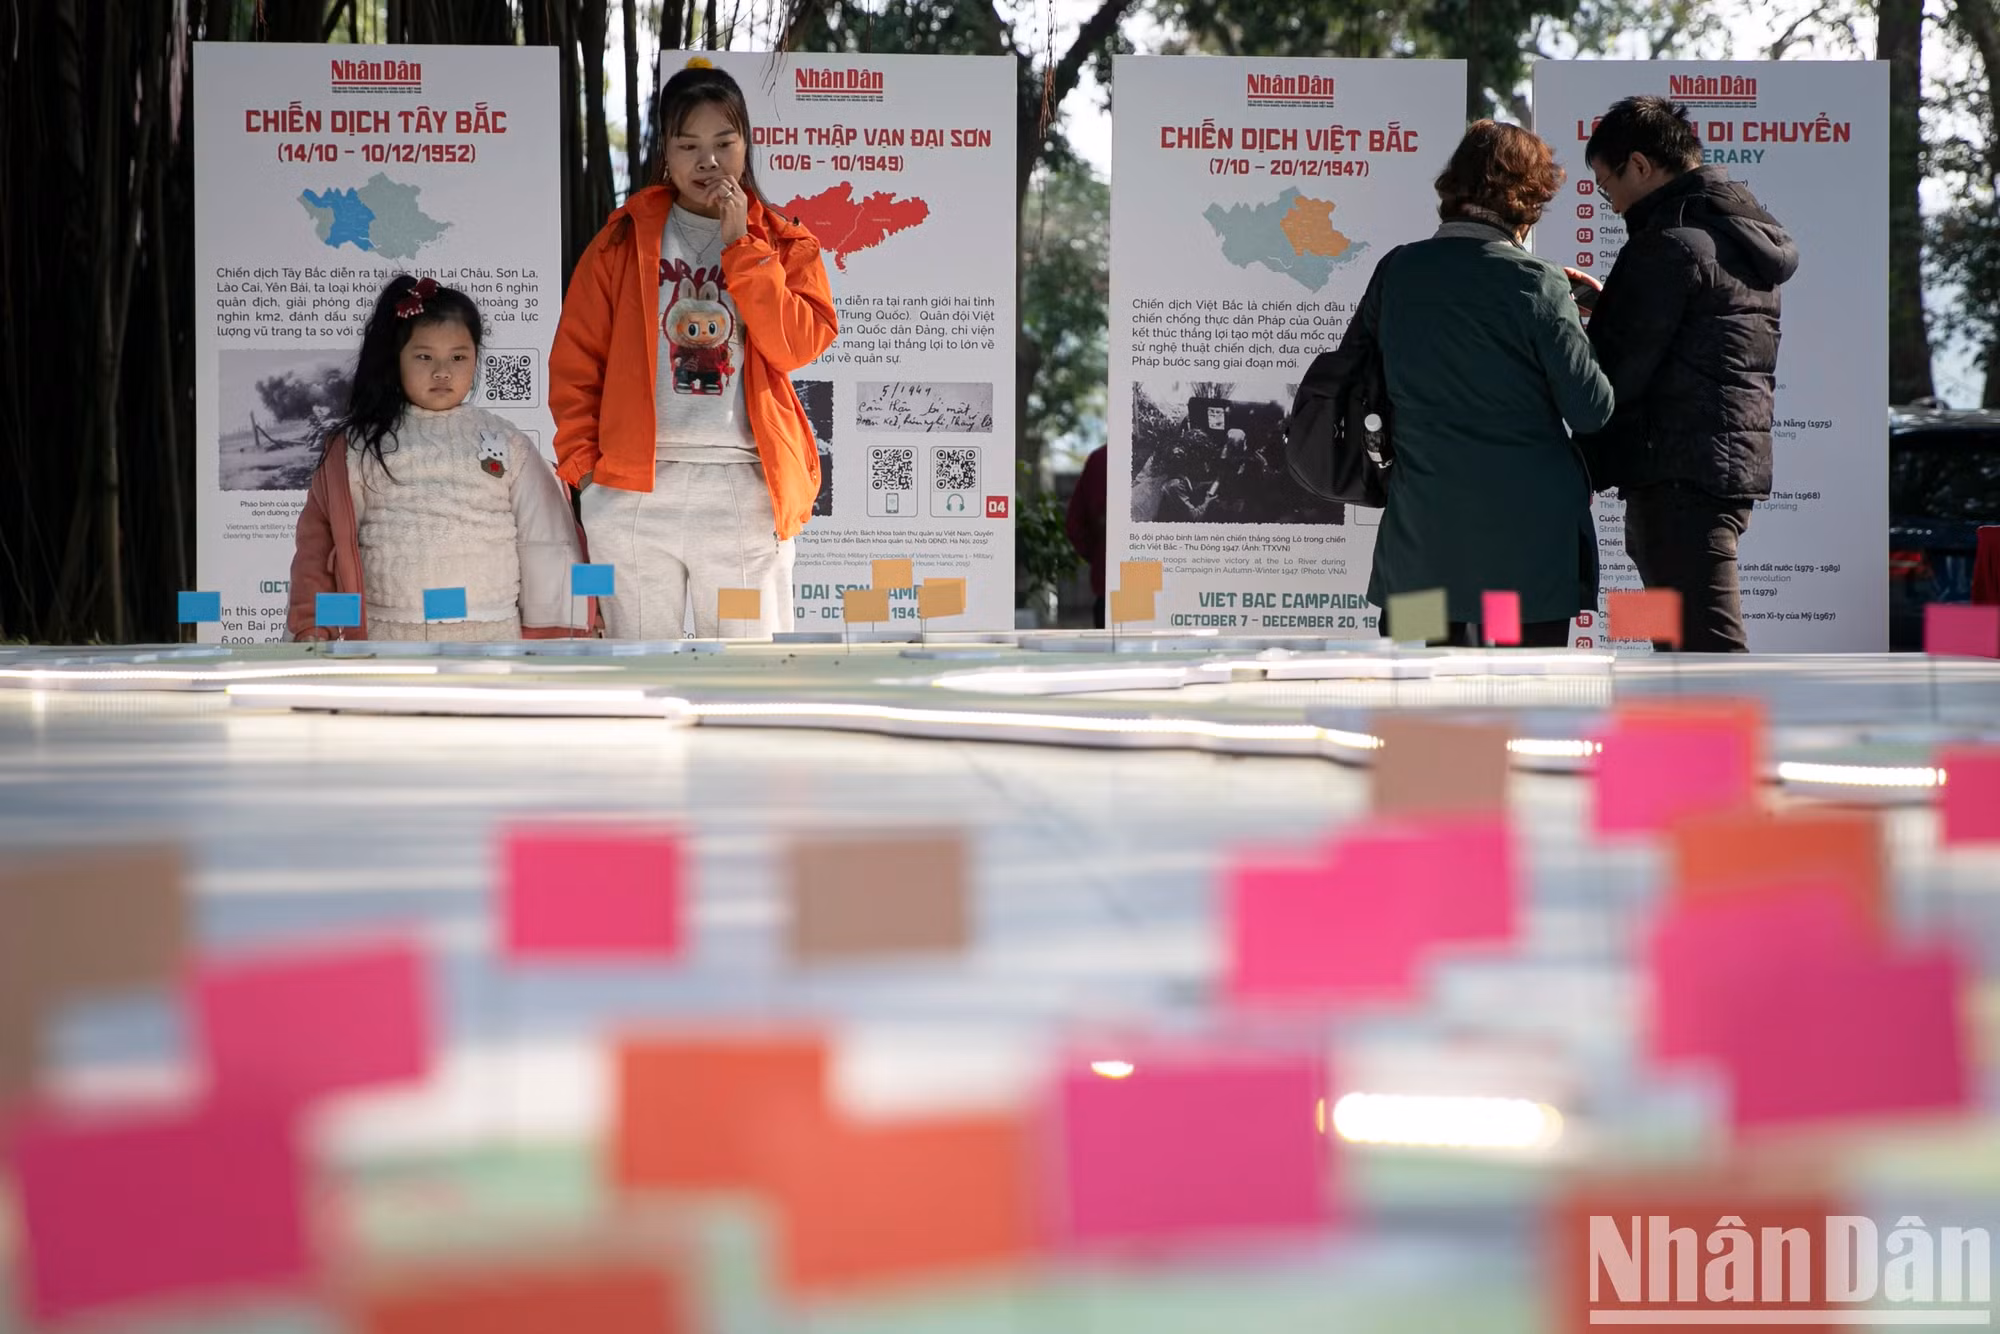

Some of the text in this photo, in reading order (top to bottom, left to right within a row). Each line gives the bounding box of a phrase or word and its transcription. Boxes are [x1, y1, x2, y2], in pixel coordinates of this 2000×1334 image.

[332, 60, 421, 80] Nhân Dân
[796, 68, 883, 89] Nhân Dân
[1248, 73, 1334, 95] Nhân Dân
[1670, 75, 1757, 95] Nhân Dân
[245, 101, 507, 136] CHIẾN DỊCH TÂY BẮC
[1709, 112, 1850, 142] DI CHUYỂN
[753, 123, 991, 150] DỊCH THẬP VẠN ĐẠI SƠN
[1161, 118, 1418, 154] CHIẾN DỊCH VIỆT BẮC
[278, 144, 338, 163] (14/10
[361, 144, 476, 163] 10/12/1952)
[1701, 149, 1765, 164] ERARY
[770, 154, 811, 172] (10/6
[831, 154, 904, 172] 10/1949)
[1209, 158, 1250, 177] (7/10
[1270, 158, 1369, 177] 20/12/1947)
[1580, 183, 1591, 192] 01
[1578, 207, 1591, 216] 02
[1578, 226, 1623, 240] 03 Chiến
[1578, 255, 1591, 264] 04
[216, 266, 538, 280] Chiến dịch Tây Bắc diễn ra tại tỉnh Lai Châu, Sơn La,
[217, 282, 238, 294] Lào
[241, 282, 262, 294] Cai,
[265, 282, 287, 294] Yên
[290, 282, 310, 294] Bái,
[314, 282, 325, 294] ta
[329, 282, 349, 295] loại
[352, 282, 376, 293] khỏi
[471, 283, 492, 294] hơn
[496, 283, 503, 294] 6
[506, 283, 538, 294] nghìn
[845, 295, 869, 306] diễn
[872, 298, 883, 306] ra
[886, 296, 900, 308] tại
[903, 296, 927, 306] ranh
[931, 296, 951, 308] giới
[954, 296, 971, 306] hai
[974, 296, 994, 306] tỉnh
[1132, 298, 1164, 309] Chiến
[1168, 299, 1192, 311] dịch
[1196, 300, 1218, 311] Việt
[1222, 299, 1243, 310] Bắc
[1248, 300, 1257, 310] là
[1262, 300, 1292, 311] chiến
[1296, 301, 1320, 313] dịch
[1324, 301, 1345, 312] đầu
[217, 311, 538, 324] nghìn km2, đánh dấu sự của lực
[836, 310, 994, 322] (Trung Quốc). Quân đội Việt
[1132, 327, 1325, 341] kết thúc thắng lợi tạo một dấu mốc
[843, 338, 994, 351] mang lại thắng lợi to lớn về
[1784, 418, 1832, 429] Nẵng (1975)
[1772, 491, 1821, 500] Thân (1968)
[988, 501, 1006, 513] 04
[1763, 503, 1797, 512] Uprising
[1599, 514, 1620, 523] Cuộc
[1599, 538, 1623, 546] Chiến
[1750, 574, 1791, 582] revolution
[801, 584, 829, 600] DAI
[1752, 588, 1777, 596] (1979)
[1199, 592, 1369, 610] VIET BAC CAMPAIGN
[222, 606, 232, 616] In
[236, 606, 257, 616] this
[221, 620, 243, 631] Yen
[248, 620, 266, 631] Bai
[1171, 614, 1237, 627] (OCTOBER
[1241, 615, 1248, 627] 7
[1263, 616, 1332, 628] DECEMBER
[1338, 616, 1359, 630] 20,
[1578, 615, 1589, 624] 19
[1577, 639, 1590, 648] 20
